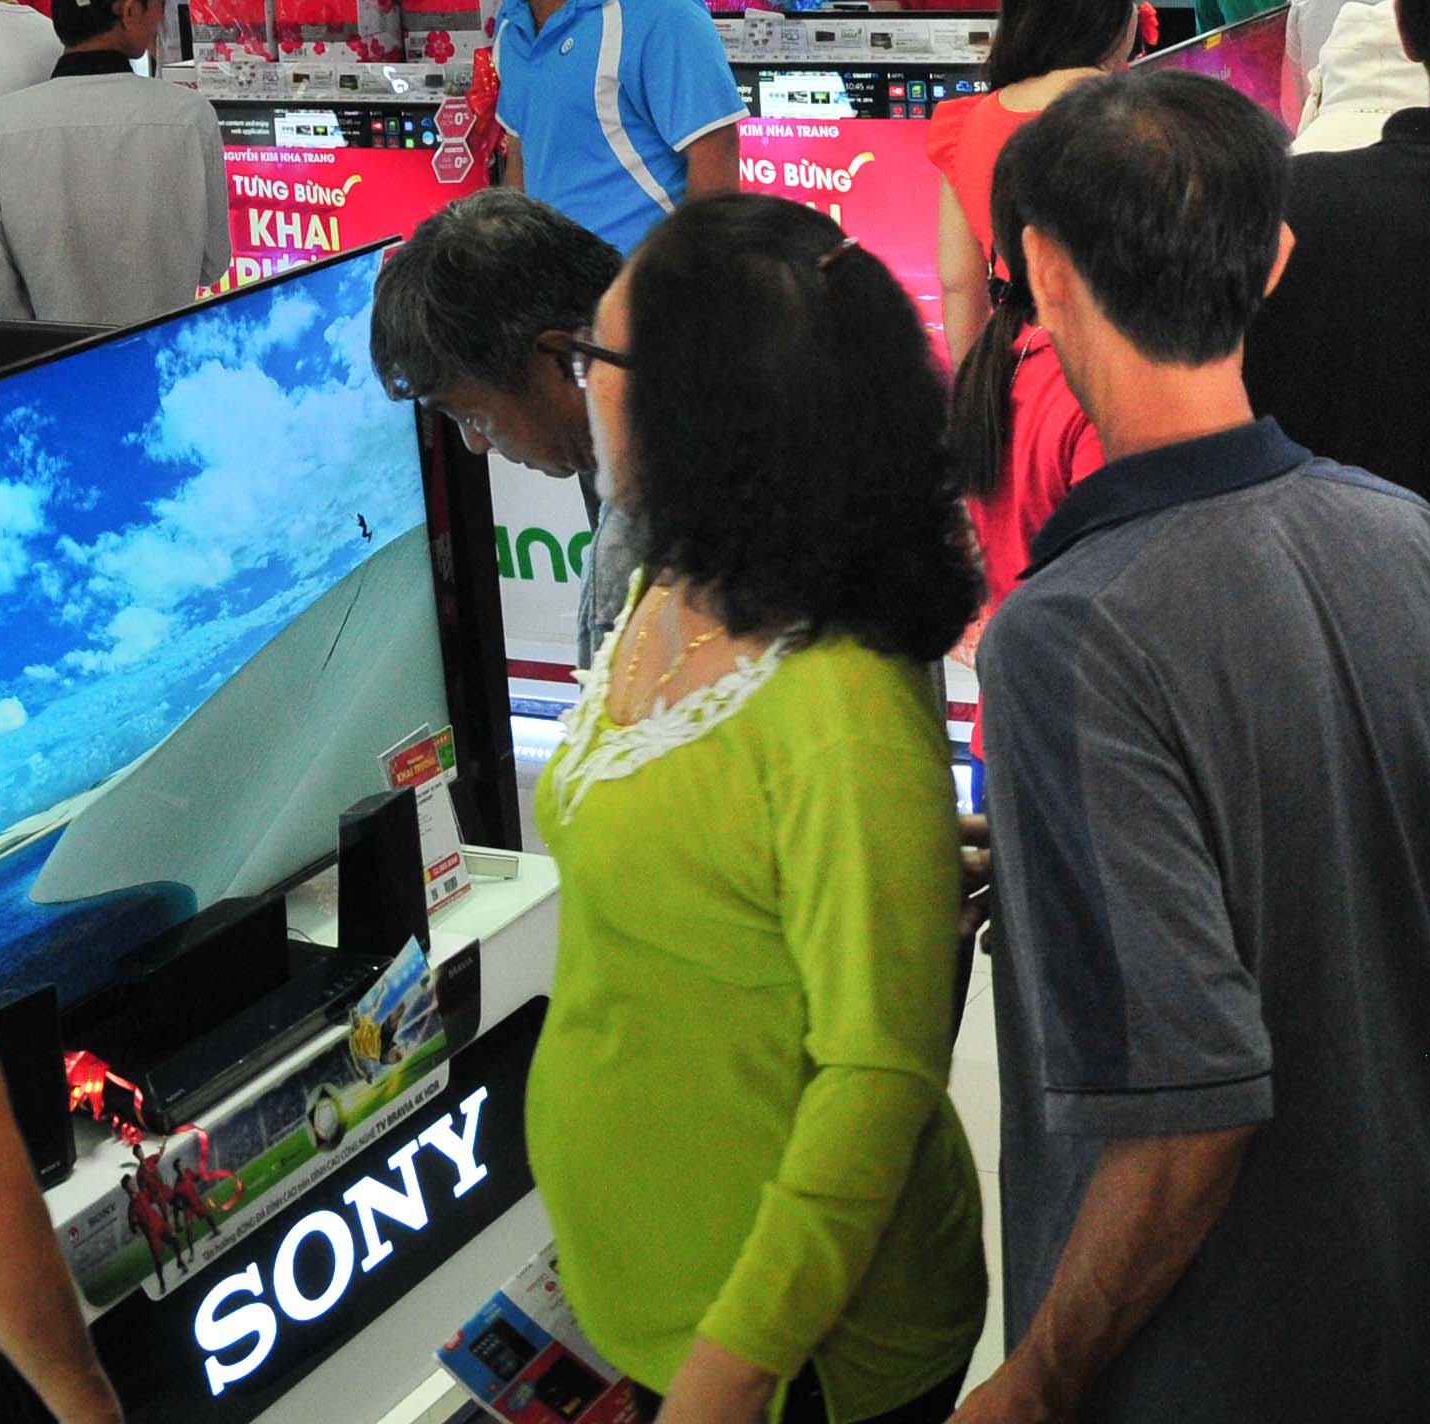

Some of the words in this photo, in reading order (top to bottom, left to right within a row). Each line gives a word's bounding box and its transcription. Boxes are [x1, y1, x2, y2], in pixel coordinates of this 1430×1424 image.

[739, 125, 764, 137] KIM
[766, 125, 793, 137] NHA
[796, 125, 839, 138] TRANG
[260, 152, 279, 163] KIM
[280, 152, 301, 163] NHA
[303, 152, 335, 164] TRANG
[739, 158, 777, 184] NG
[783, 157, 852, 193] BỪNG
[232, 174, 289, 201] TƯNG
[294, 178, 347, 208] BỪNG
[248, 208, 341, 252] KHAI
[195, 1085, 488, 1396] SONY
